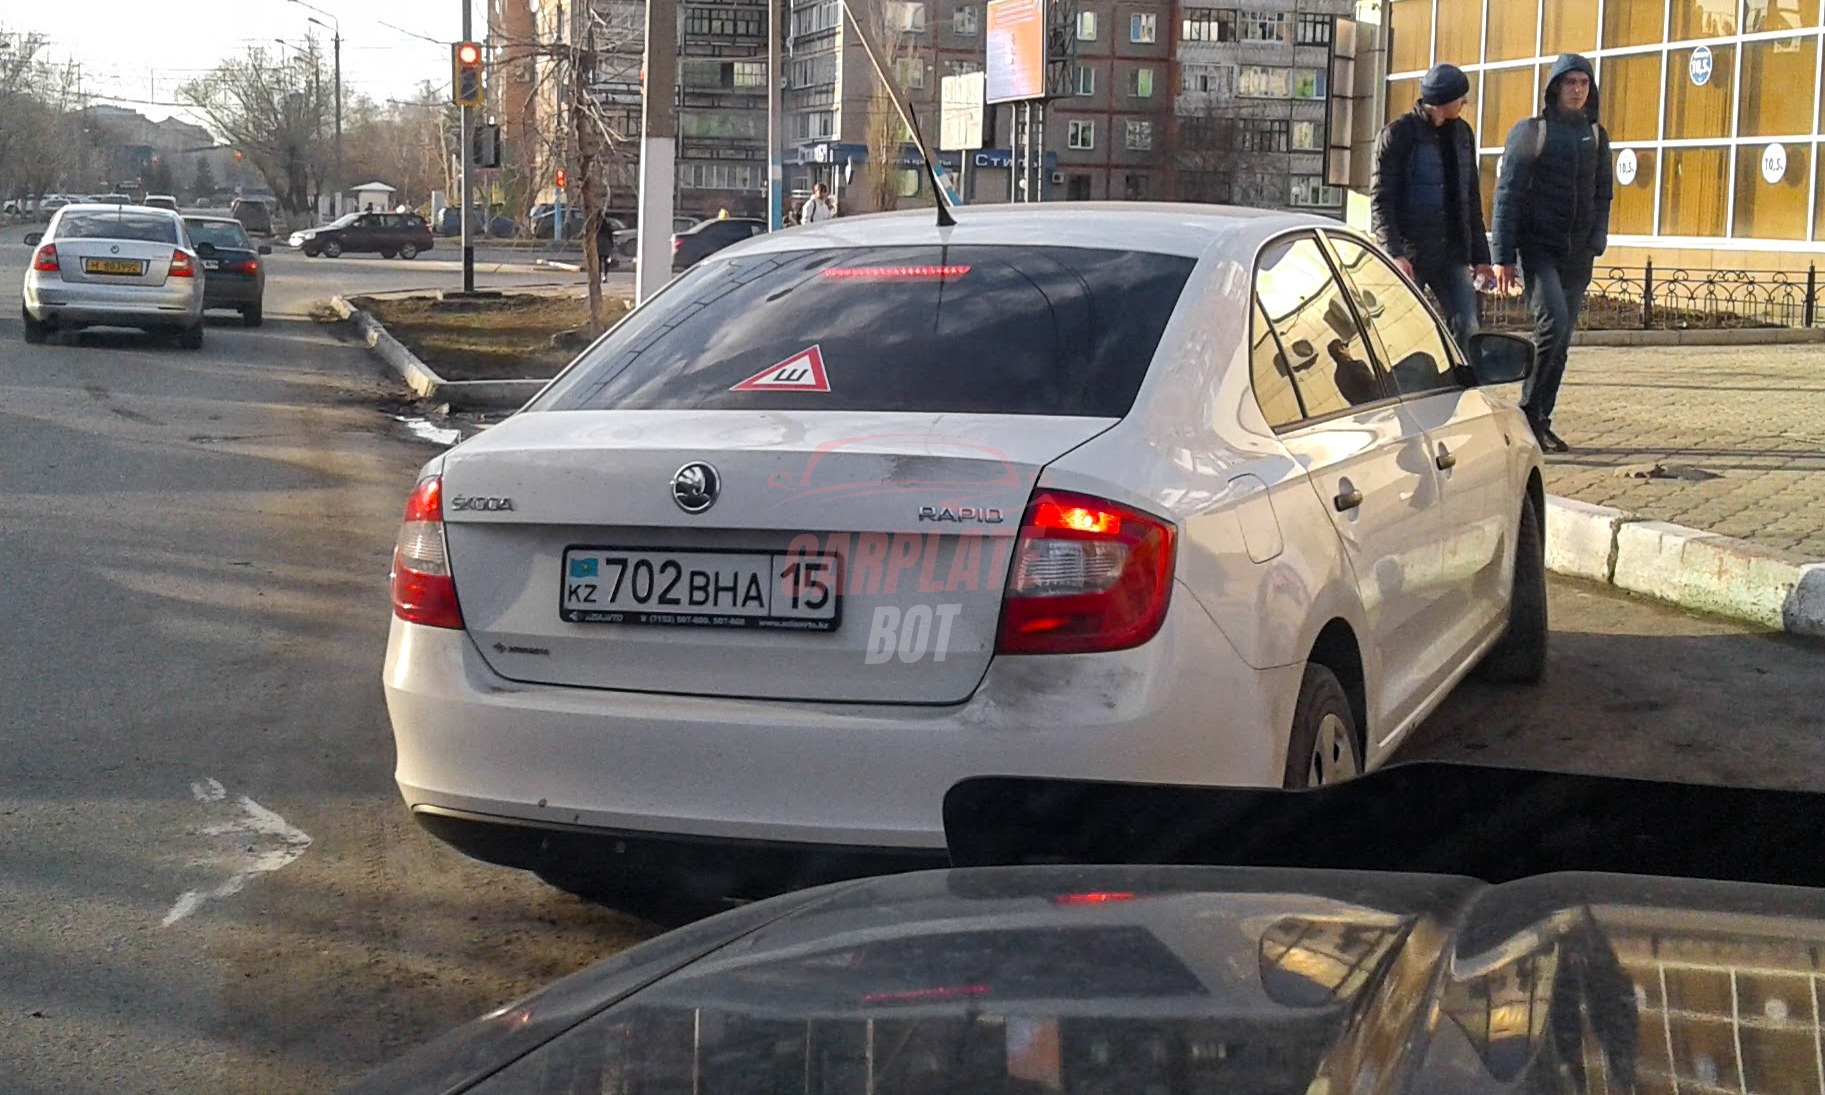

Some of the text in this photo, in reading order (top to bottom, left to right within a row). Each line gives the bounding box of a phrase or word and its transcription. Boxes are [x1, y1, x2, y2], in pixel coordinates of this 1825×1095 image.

[773, 369, 808, 381] Ш
[918, 506, 1004, 523] RAPID
[568, 585, 597, 603] KZ
[780, 562, 829, 609] 15
